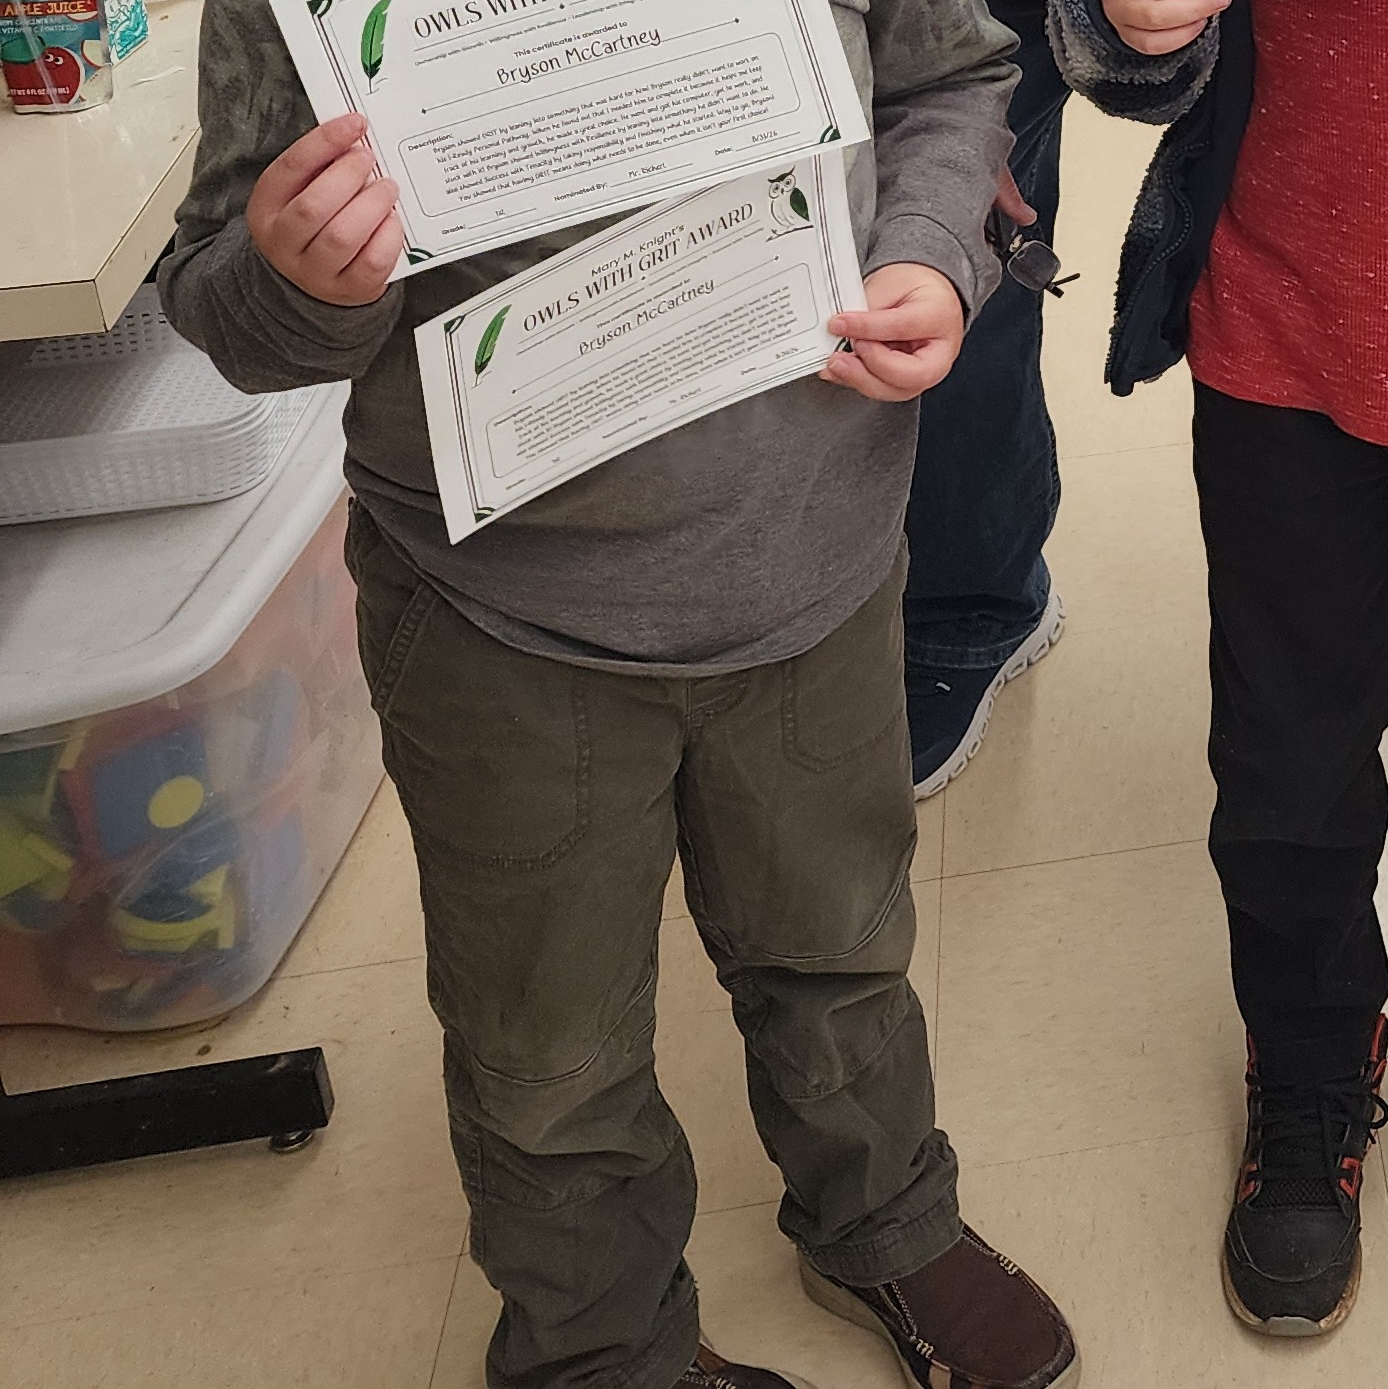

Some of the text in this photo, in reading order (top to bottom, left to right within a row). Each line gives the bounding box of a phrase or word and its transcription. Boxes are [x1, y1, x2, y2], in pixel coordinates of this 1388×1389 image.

[414, 1, 482, 38] OWLS
[513, 48, 531, 58] This
[531, 37, 573, 53] certificate
[581, 22, 618, 38] awarded
[496, 28, 663, 88] Bryson McCartney
[407, 133, 454, 152] Description:
[553, 184, 596, 202] Nominated
[523, 290, 580, 332] OWLS
[584, 262, 633, 299] WITH
[638, 238, 680, 271] GRIT
[686, 203, 752, 249] AWARD
[591, 224, 684, 277] Mary M. Knight's
[579, 321, 632, 357] Bryson
[636, 279, 715, 327] McCartney
